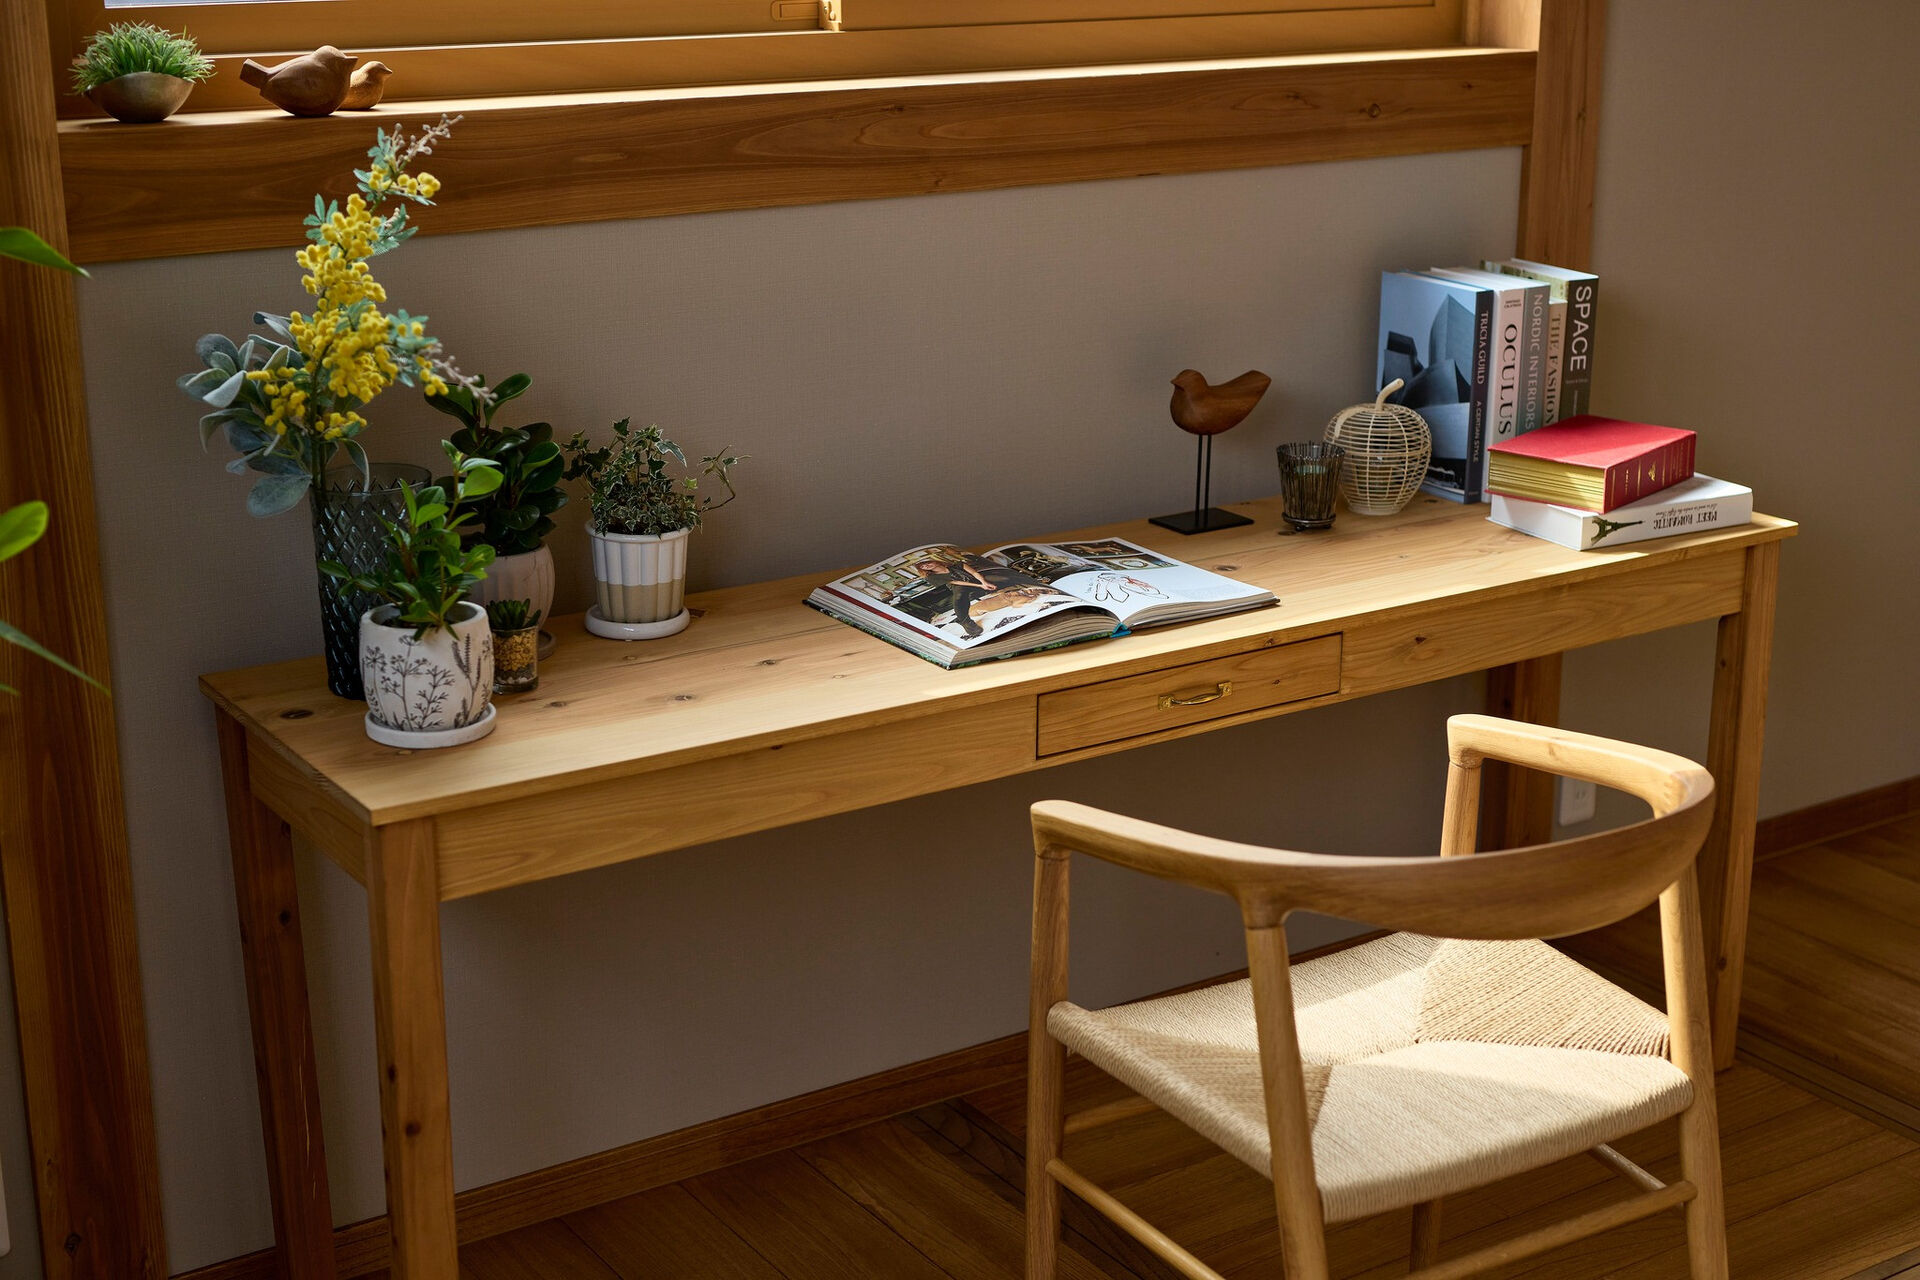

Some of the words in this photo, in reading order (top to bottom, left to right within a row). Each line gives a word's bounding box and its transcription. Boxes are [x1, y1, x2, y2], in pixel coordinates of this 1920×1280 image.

[1479, 310, 1489, 349] TRICIA
[1530, 294, 1543, 351] NORDIC
[1549, 313, 1561, 350] THE
[1570, 286, 1592, 372] SPACE
[1477, 350, 1487, 385] GUILD
[1498, 323, 1518, 435] OCULUS
[1525, 355, 1539, 429] INTERIORS
[1653, 514, 1693, 530] ROMANTIC
[1696, 511, 1718, 524] MEET
